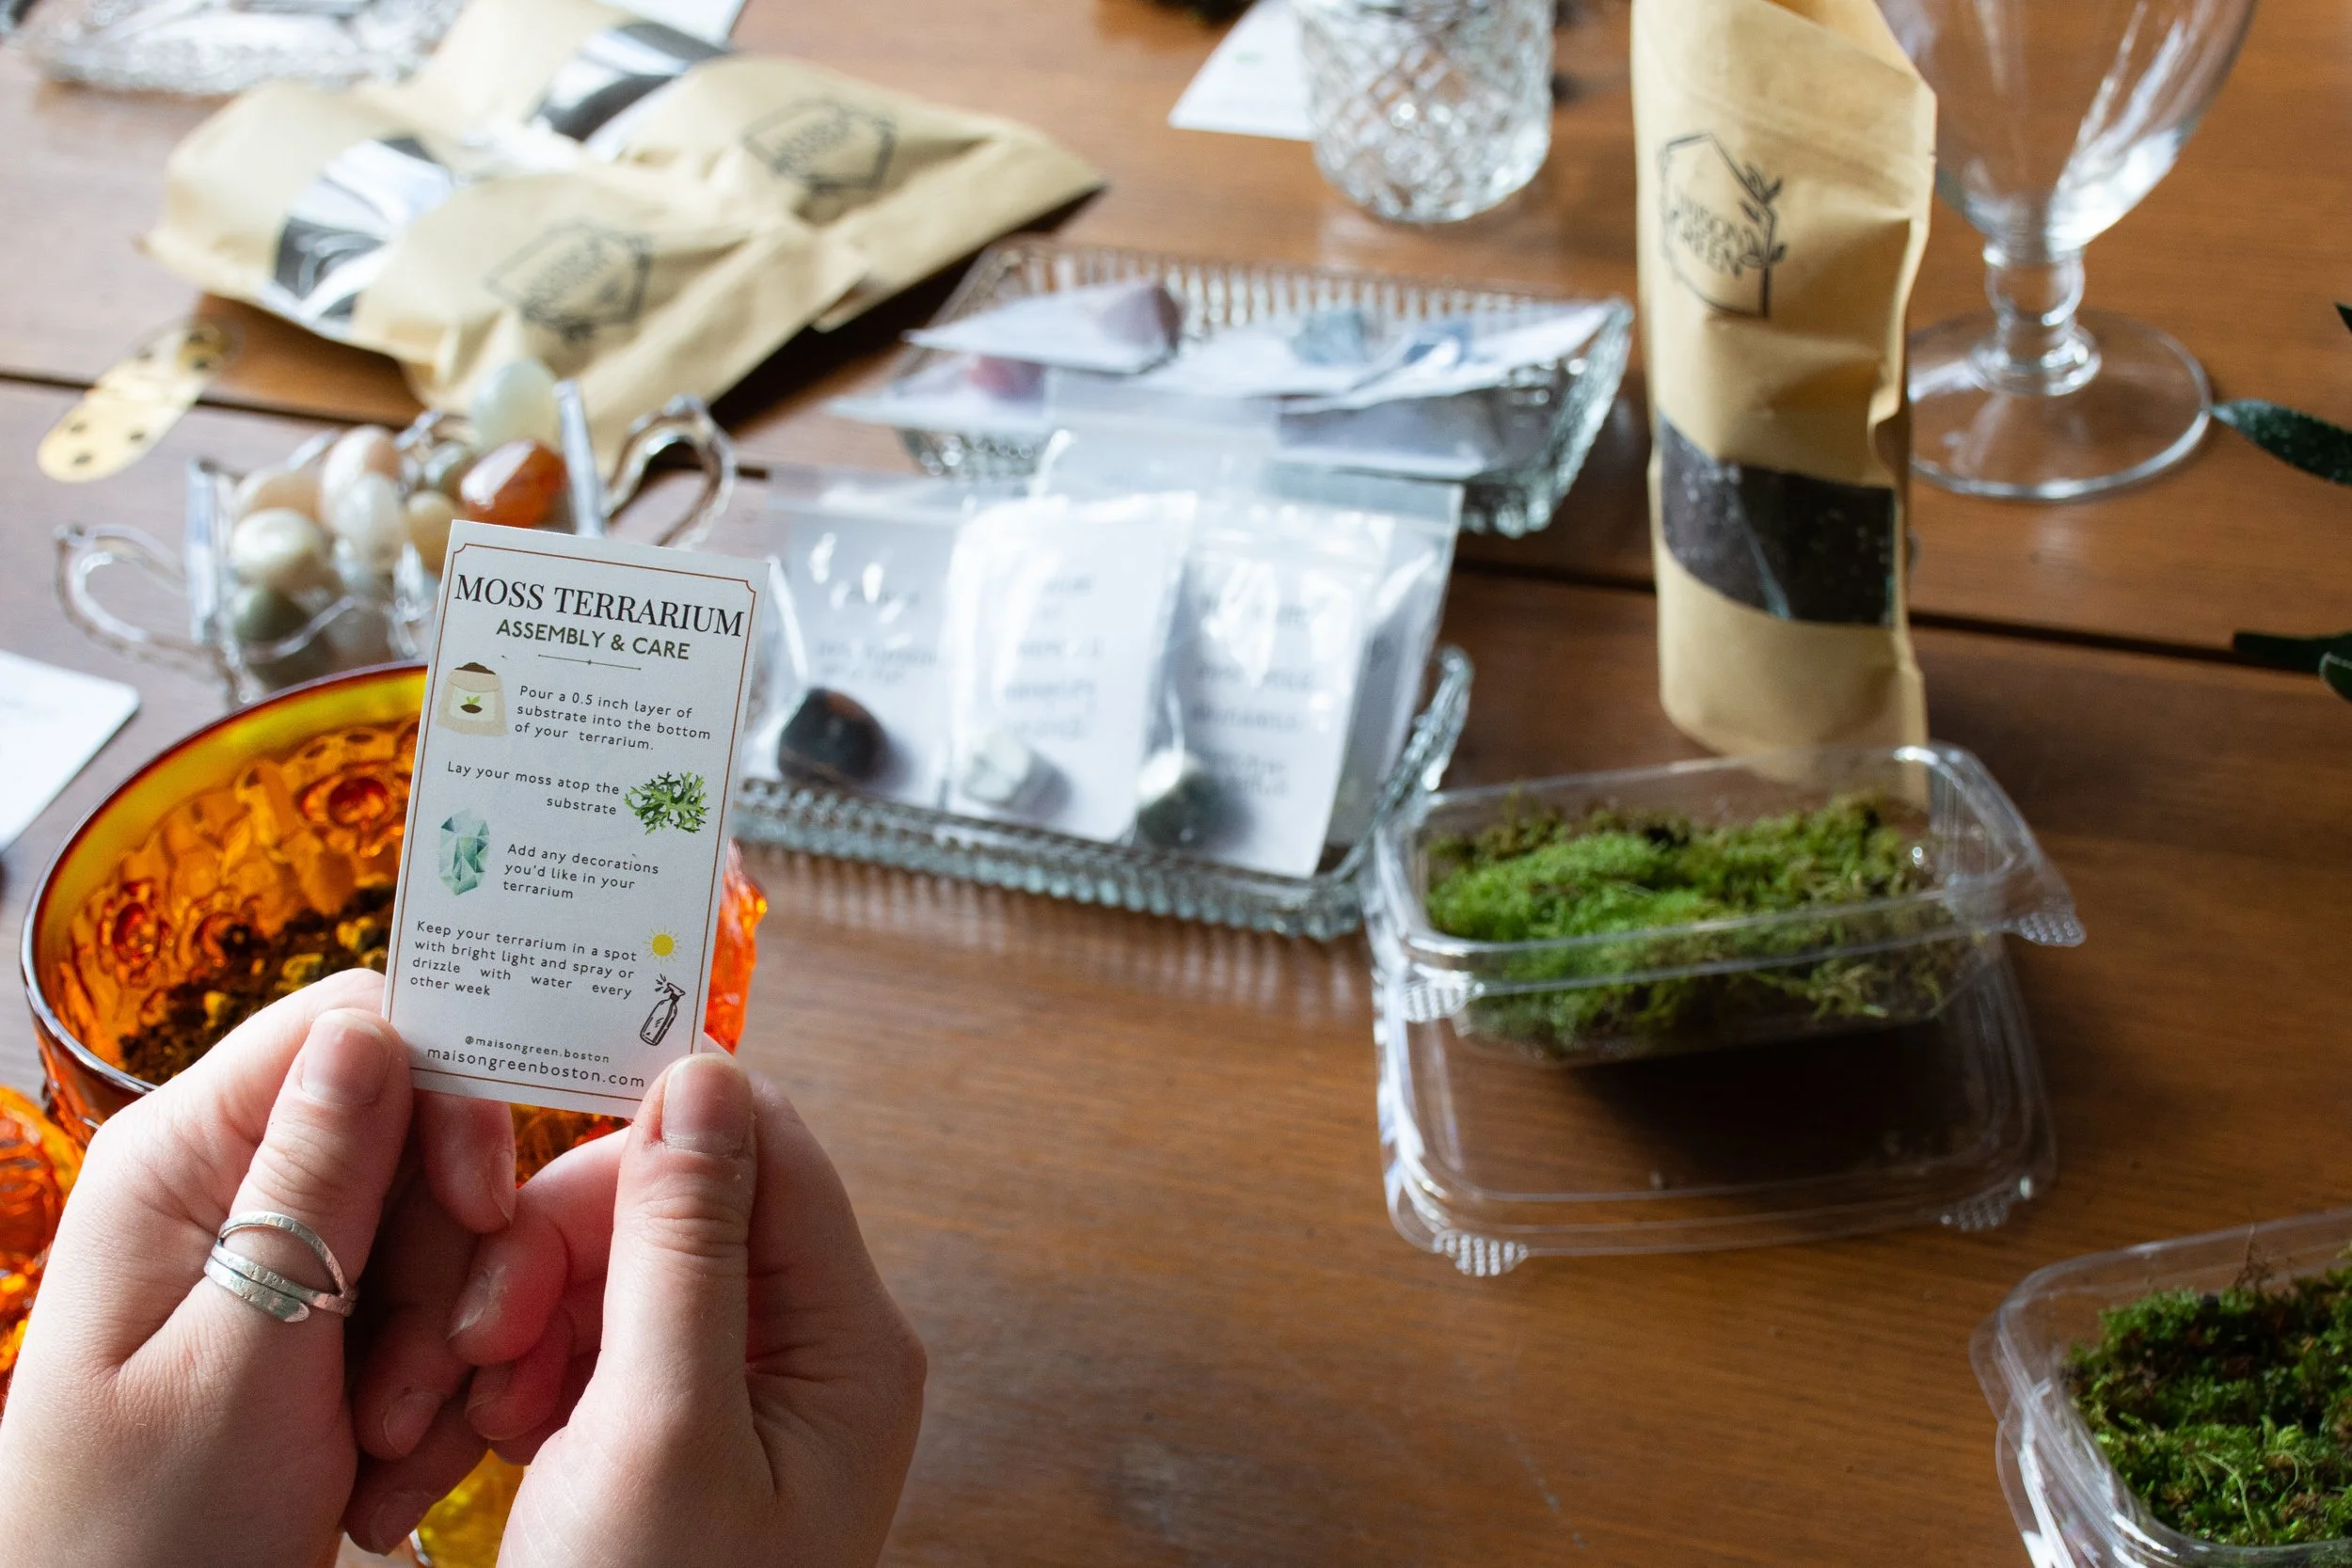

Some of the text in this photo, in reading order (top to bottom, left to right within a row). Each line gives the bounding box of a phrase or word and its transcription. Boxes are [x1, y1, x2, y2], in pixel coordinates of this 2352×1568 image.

[453, 574, 745, 638] MOSS TERRARIUM
[495, 618, 691, 660] ASSEMBLY & CARE
[519, 685, 693, 719] Pour a 0.5 inch layer of
[515, 721, 655, 751] of your terrarium.
[516, 705, 710, 740] substrate into the bottom
[447, 760, 620, 796] Lay your moss atop the
[546, 797, 617, 816] substrate
[507, 843, 659, 875] Add any decorations
[502, 879, 574, 899] terrarium
[503, 863, 636, 890] you'd like in your
[417, 920, 637, 962] Keep your terrarium in a spot
[414, 941, 635, 979] with bright light and spray or
[409, 975, 490, 996] other week
[412, 957, 632, 1001] drizzle with water every
[426, 1045, 645, 1088] maisongreenboston.com
[465, 1035, 610, 1064] @maisongreen.boston
